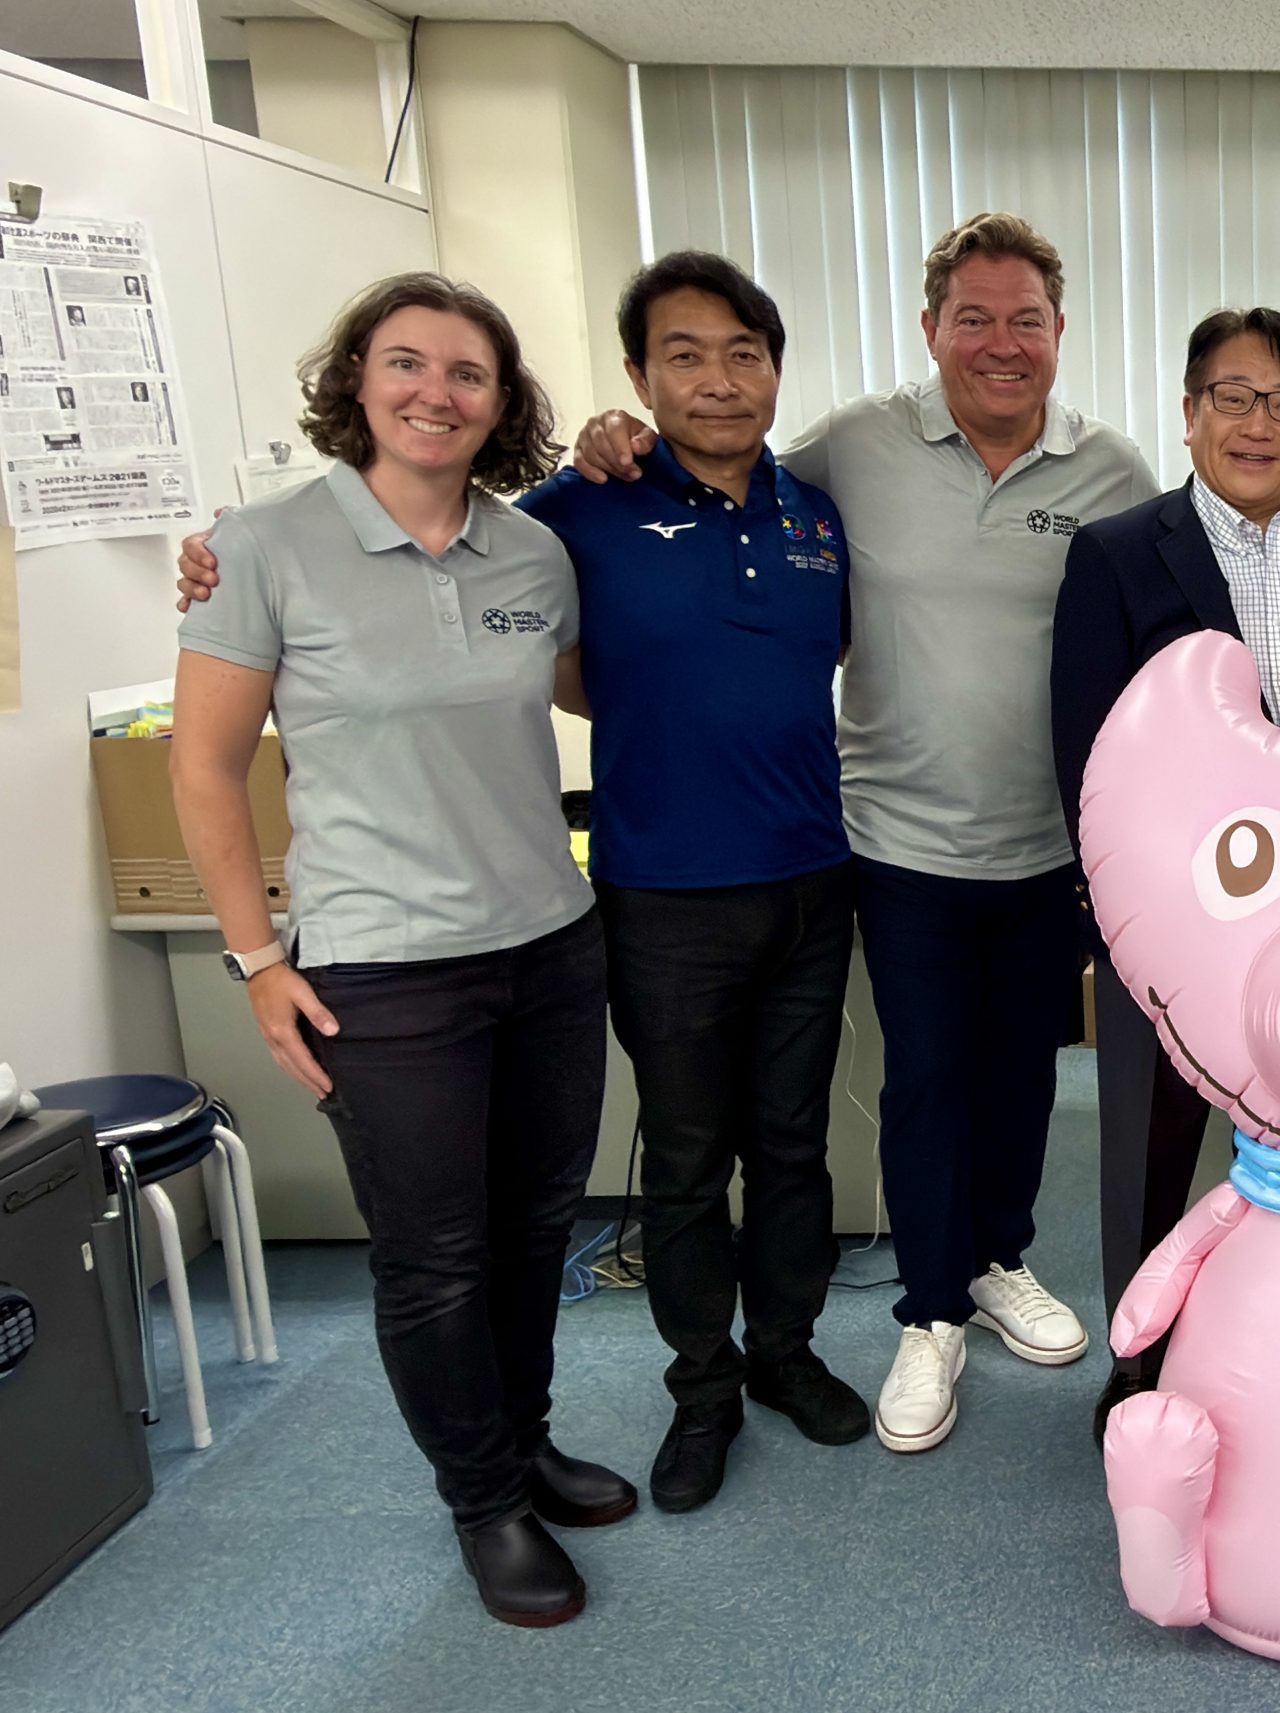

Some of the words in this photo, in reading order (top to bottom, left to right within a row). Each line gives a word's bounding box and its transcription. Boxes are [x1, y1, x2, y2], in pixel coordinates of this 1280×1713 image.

[1053, 513, 1079, 524] WORLD
[1053, 528, 1074, 536] SPOR
[509, 610, 542, 619] WORLD
[515, 625, 545, 633] SPORT
